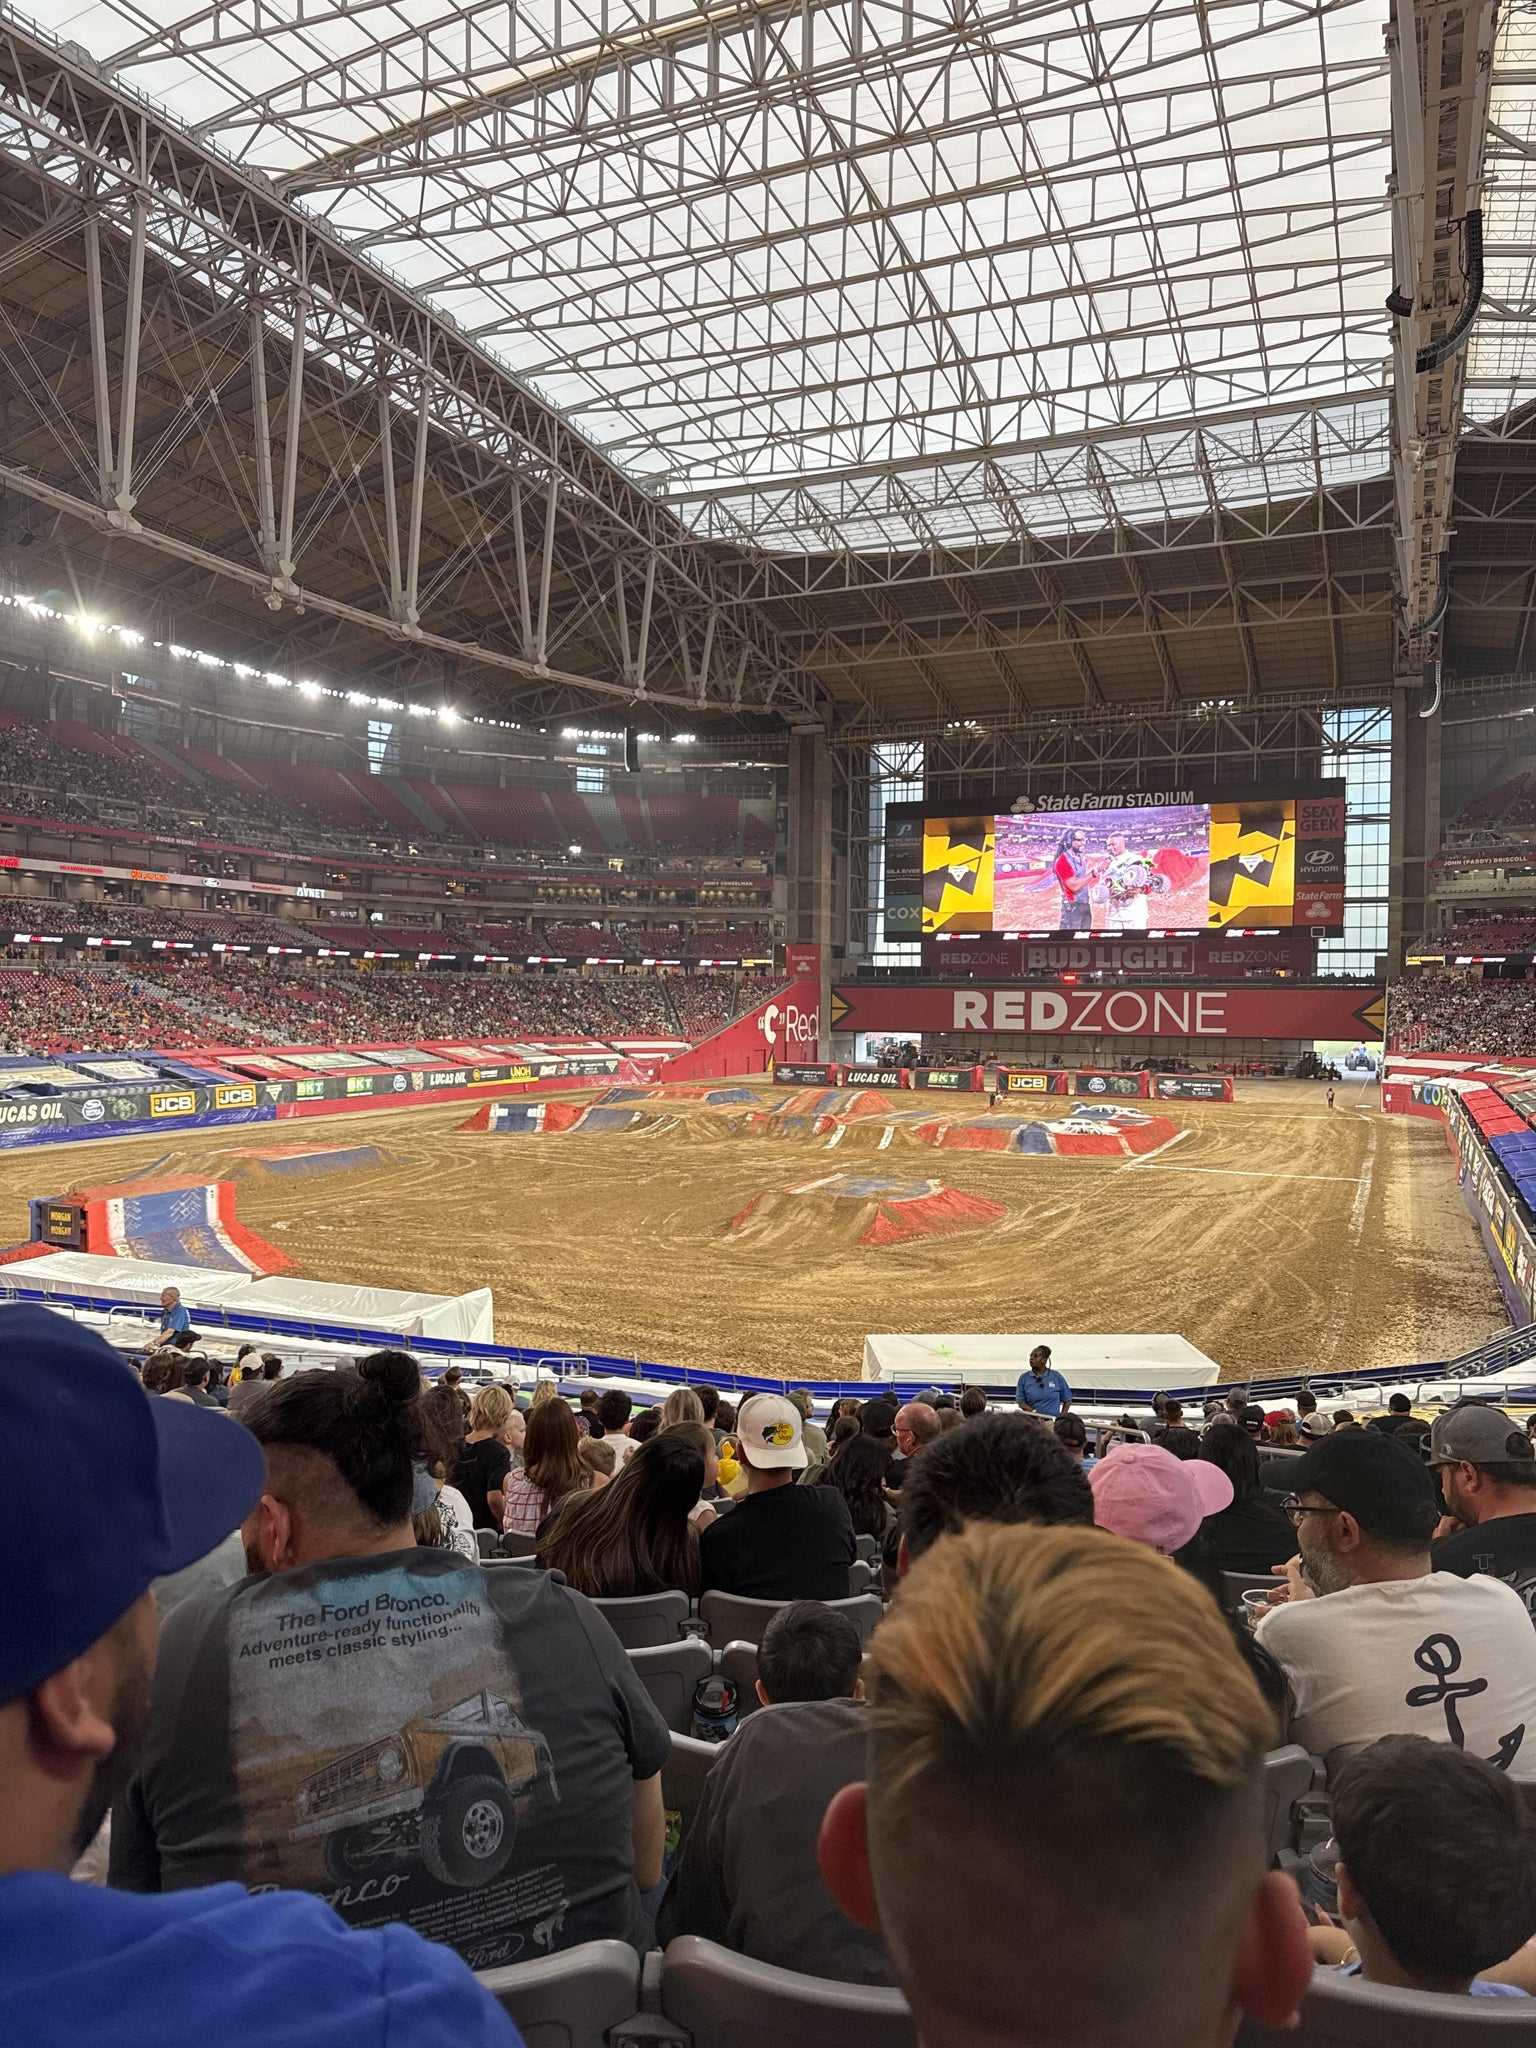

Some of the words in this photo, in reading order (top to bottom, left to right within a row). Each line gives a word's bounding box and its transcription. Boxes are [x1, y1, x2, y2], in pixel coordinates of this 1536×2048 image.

[1126, 791, 1194, 807] STADIUM
[1302, 805, 1338, 819] SEAT
[1301, 818, 1340, 832] GEEK
[887, 907, 920, 920] COX
[940, 952, 1009, 965] REDZONE
[1028, 947, 1090, 968] BUD
[1095, 946, 1184, 968] LIGHT
[1208, 950, 1291, 963] REDZONE
[953, 990, 1228, 1034] REDZONE
[430, 1073, 453, 1086] LUCAS
[454, 1071, 467, 1084] OIL
[510, 1066, 531, 1077] UNOH
[848, 1072, 879, 1084] LUCAS
[880, 1072, 898, 1084] OIL
[929, 1072, 958, 1083] BKT
[297, 1082, 324, 1096] BKT
[347, 1077, 373, 1092] BKT
[1011, 1078, 1044, 1089] JCB
[219, 1089, 253, 1104] JCB
[155, 1096, 192, 1112] JCB
[50, 1211, 71, 1223] MORGAN
[50, 1225, 72, 1237] MORGAN
[276, 1611, 316, 1632] The
[321, 1600, 370, 1623] Ford
[375, 1593, 450, 1613] Bronco.
[239, 1618, 382, 1659] Adventure-ready
[386, 1601, 482, 1631] functionality
[268, 1648, 322, 1669] meets
[326, 1633, 387, 1658] classic
[391, 1625, 463, 1648] styling...
[467, 1940, 511, 1968] Ford
